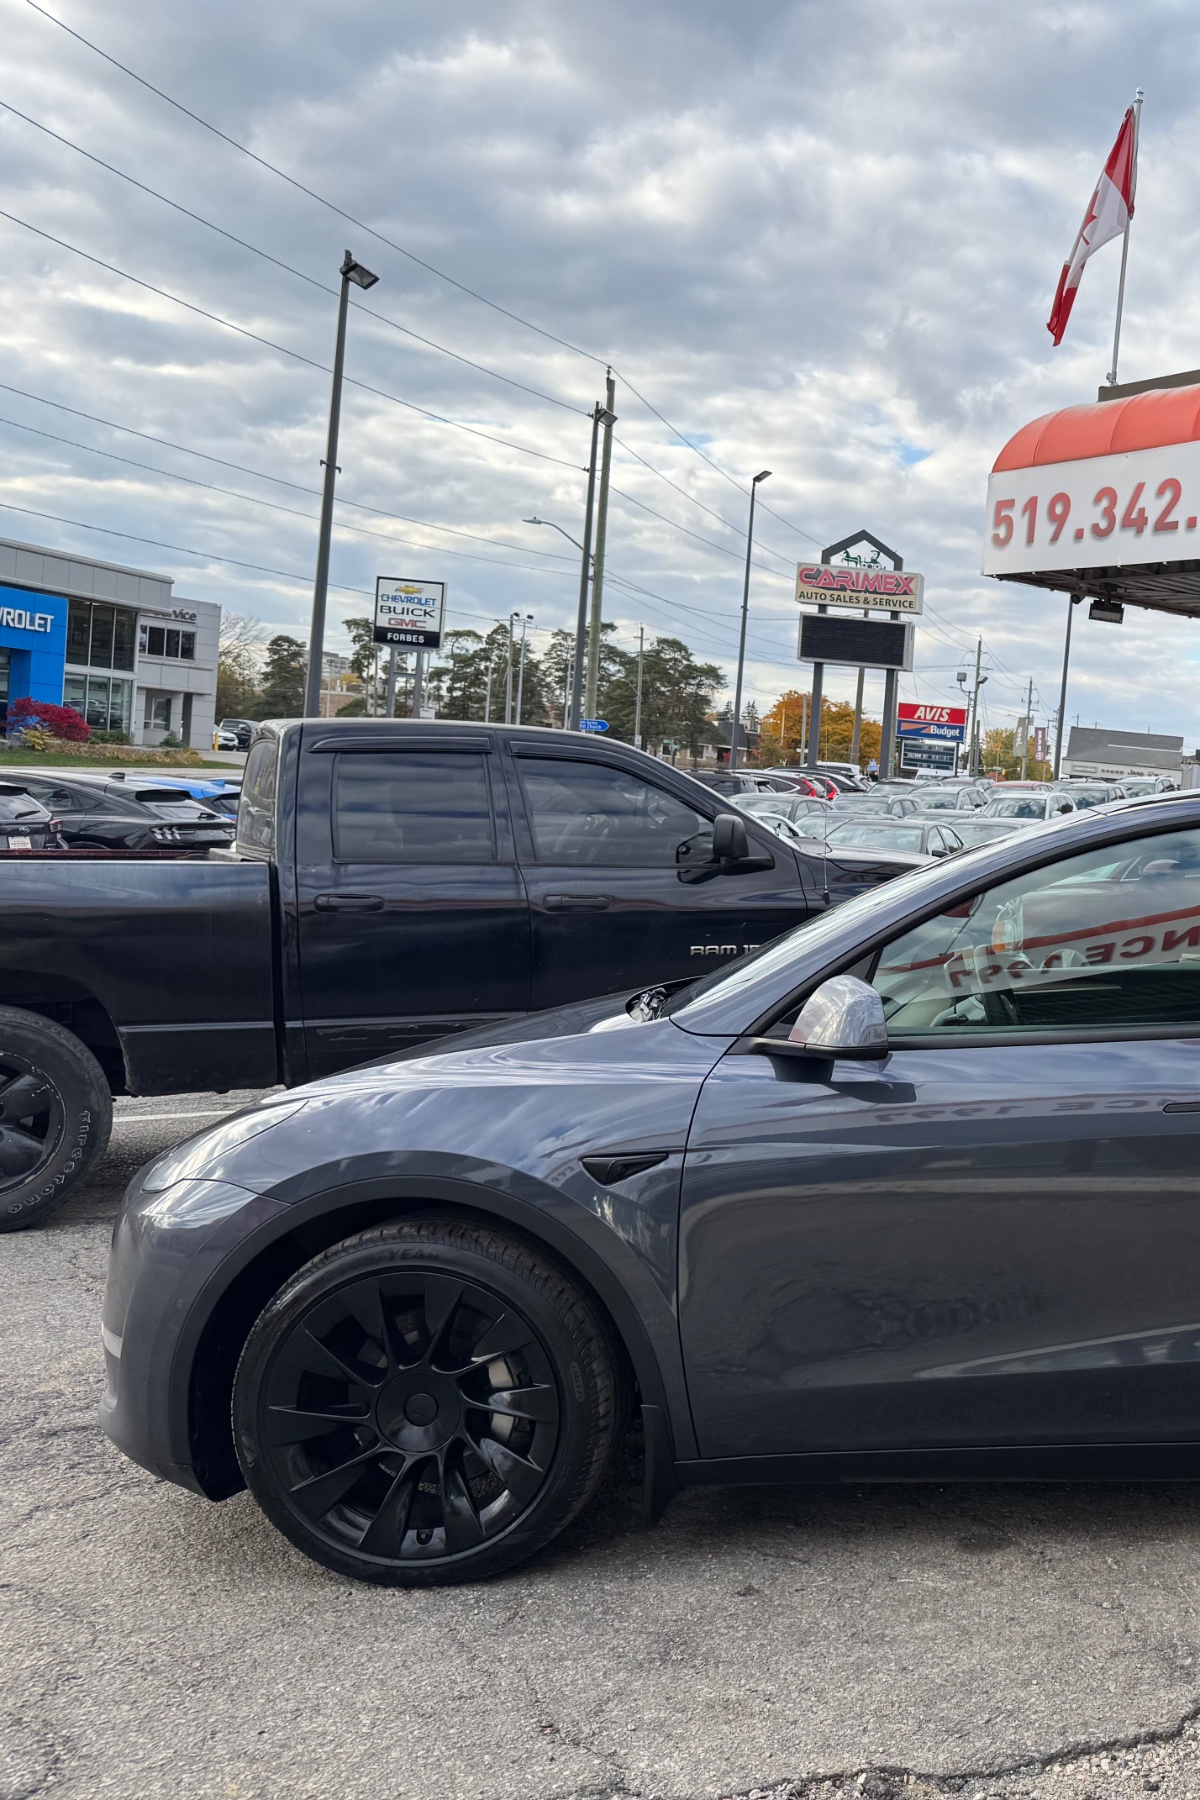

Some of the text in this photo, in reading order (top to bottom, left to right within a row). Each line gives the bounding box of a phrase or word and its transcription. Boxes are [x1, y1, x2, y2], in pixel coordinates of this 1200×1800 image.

[800, 567, 918, 595] CARIMEX
[381, 594, 437, 606] CHEVROLET
[799, 591, 915, 609] AUTO SALES & SERVICE
[380, 605, 436, 618] BUICK
[388, 618, 427, 628] GMC
[387, 633, 425, 644] FORBES
[913, 706, 951, 722] AVIS
[930, 725, 960, 738] Budget
[690, 944, 737, 956] RAM
